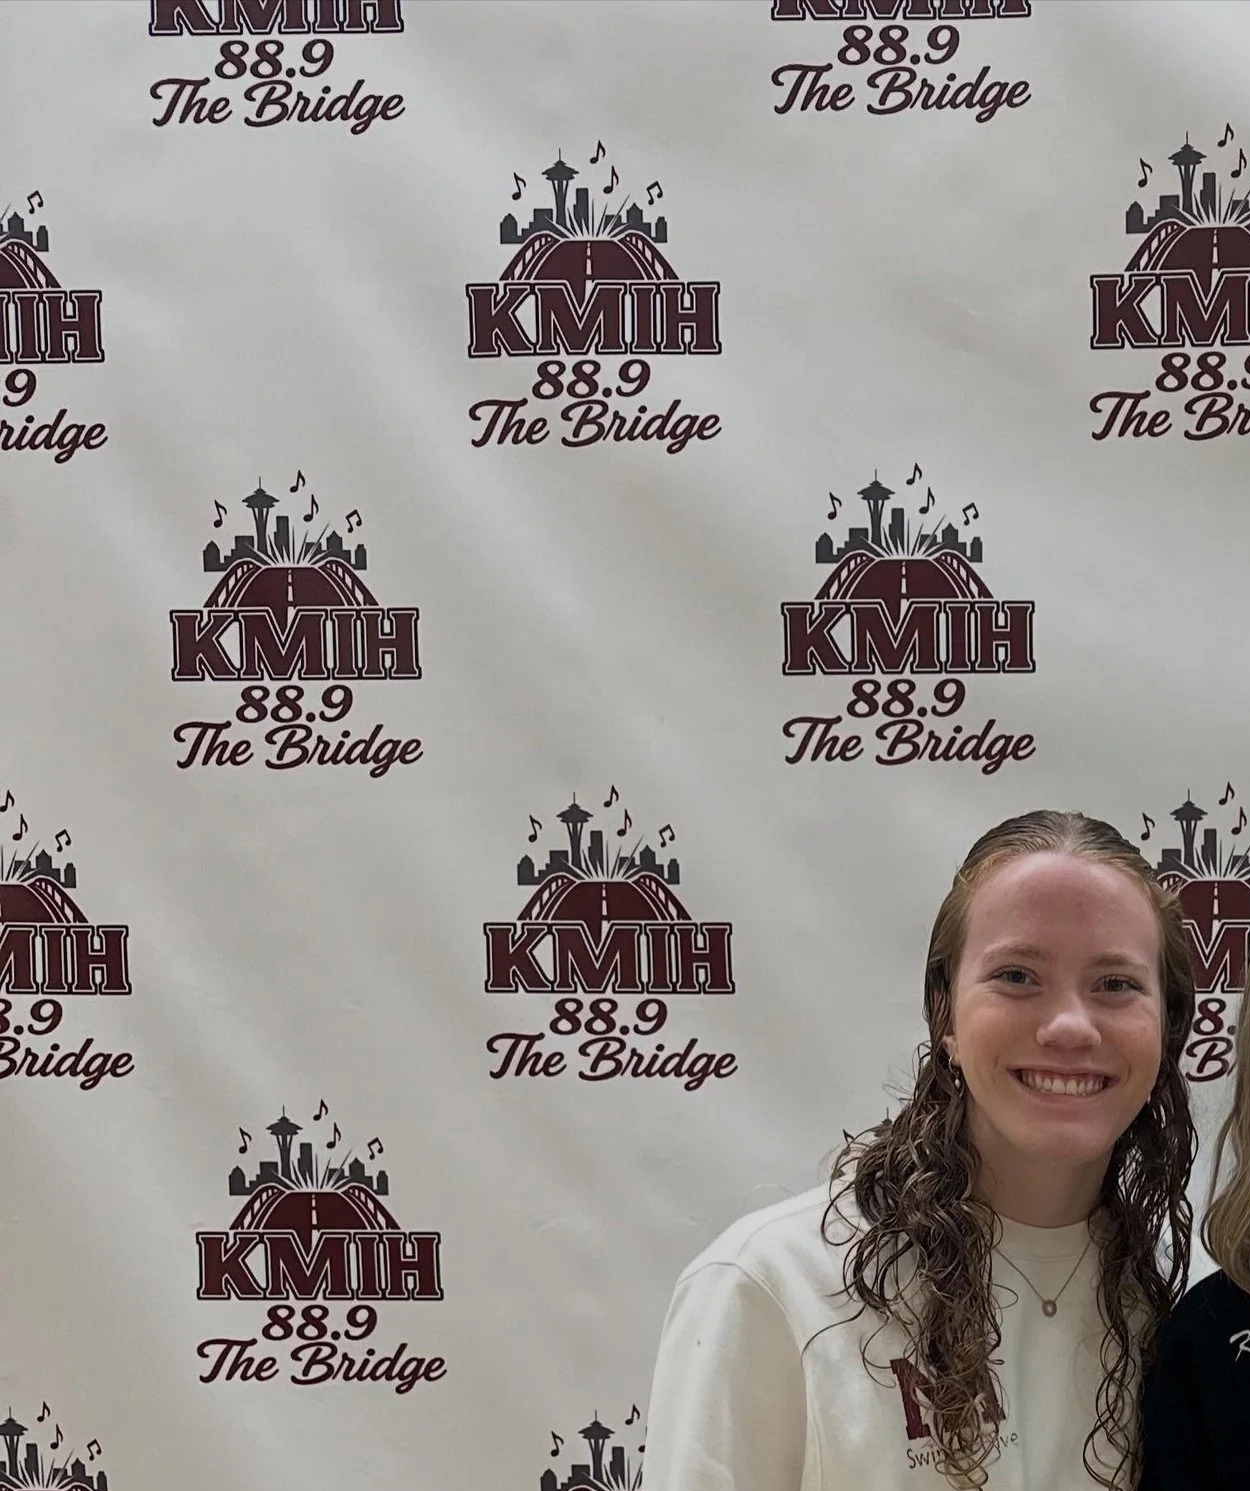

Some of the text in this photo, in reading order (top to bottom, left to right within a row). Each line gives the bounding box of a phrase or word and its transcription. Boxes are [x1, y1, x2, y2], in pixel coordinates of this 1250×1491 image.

[215, 39, 334, 79] 88.9
[837, 25, 959, 65] 88.9
[150, 77, 405, 135] The Bridge
[771, 63, 1031, 123] The Bridge
[465, 281, 722, 359] KMIH
[532, 359, 650, 400] 88.9
[0, 409, 108, 464] ridge
[469, 398, 722, 454] The Bridge
[1090, 390, 1172, 440] The
[169, 607, 422, 682] KMIH
[781, 600, 1036, 676] KMIH
[236, 685, 353, 723] 88.9
[847, 678, 965, 718] 88.9
[174, 720, 423, 778] The Bridge
[783, 715, 1036, 775] The Bridge
[483, 922, 736, 995] KMIH
[550, 998, 667, 1035] 88.9
[486, 1032, 738, 1091] The Bridge
[196, 1231, 444, 1301] KMIH
[262, 1304, 377, 1341] 88.9
[197, 1338, 447, 1394] The Bridge
